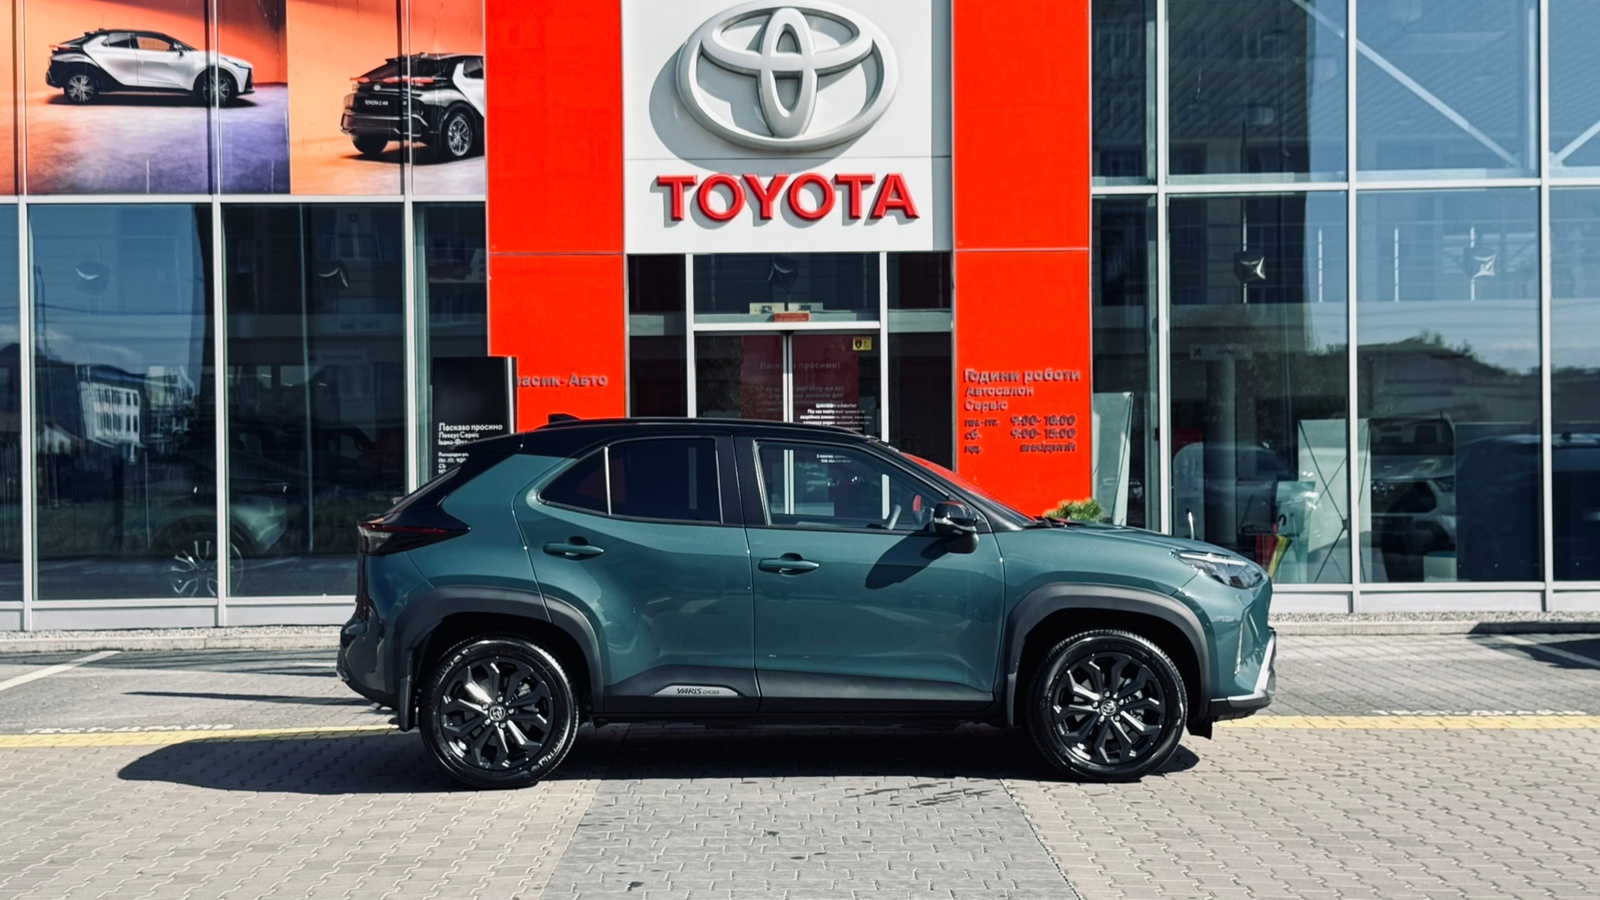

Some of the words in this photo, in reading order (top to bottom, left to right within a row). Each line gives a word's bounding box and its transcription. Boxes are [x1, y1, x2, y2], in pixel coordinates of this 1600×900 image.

[656, 172, 920, 222] TOYOTA
[964, 368, 1020, 384] Години
[1024, 367, 1080, 384] роботи
[965, 386, 1034, 397] Автосалон
[964, 400, 1008, 413] Сервіс
[438, 422, 470, 431] Ласкаво
